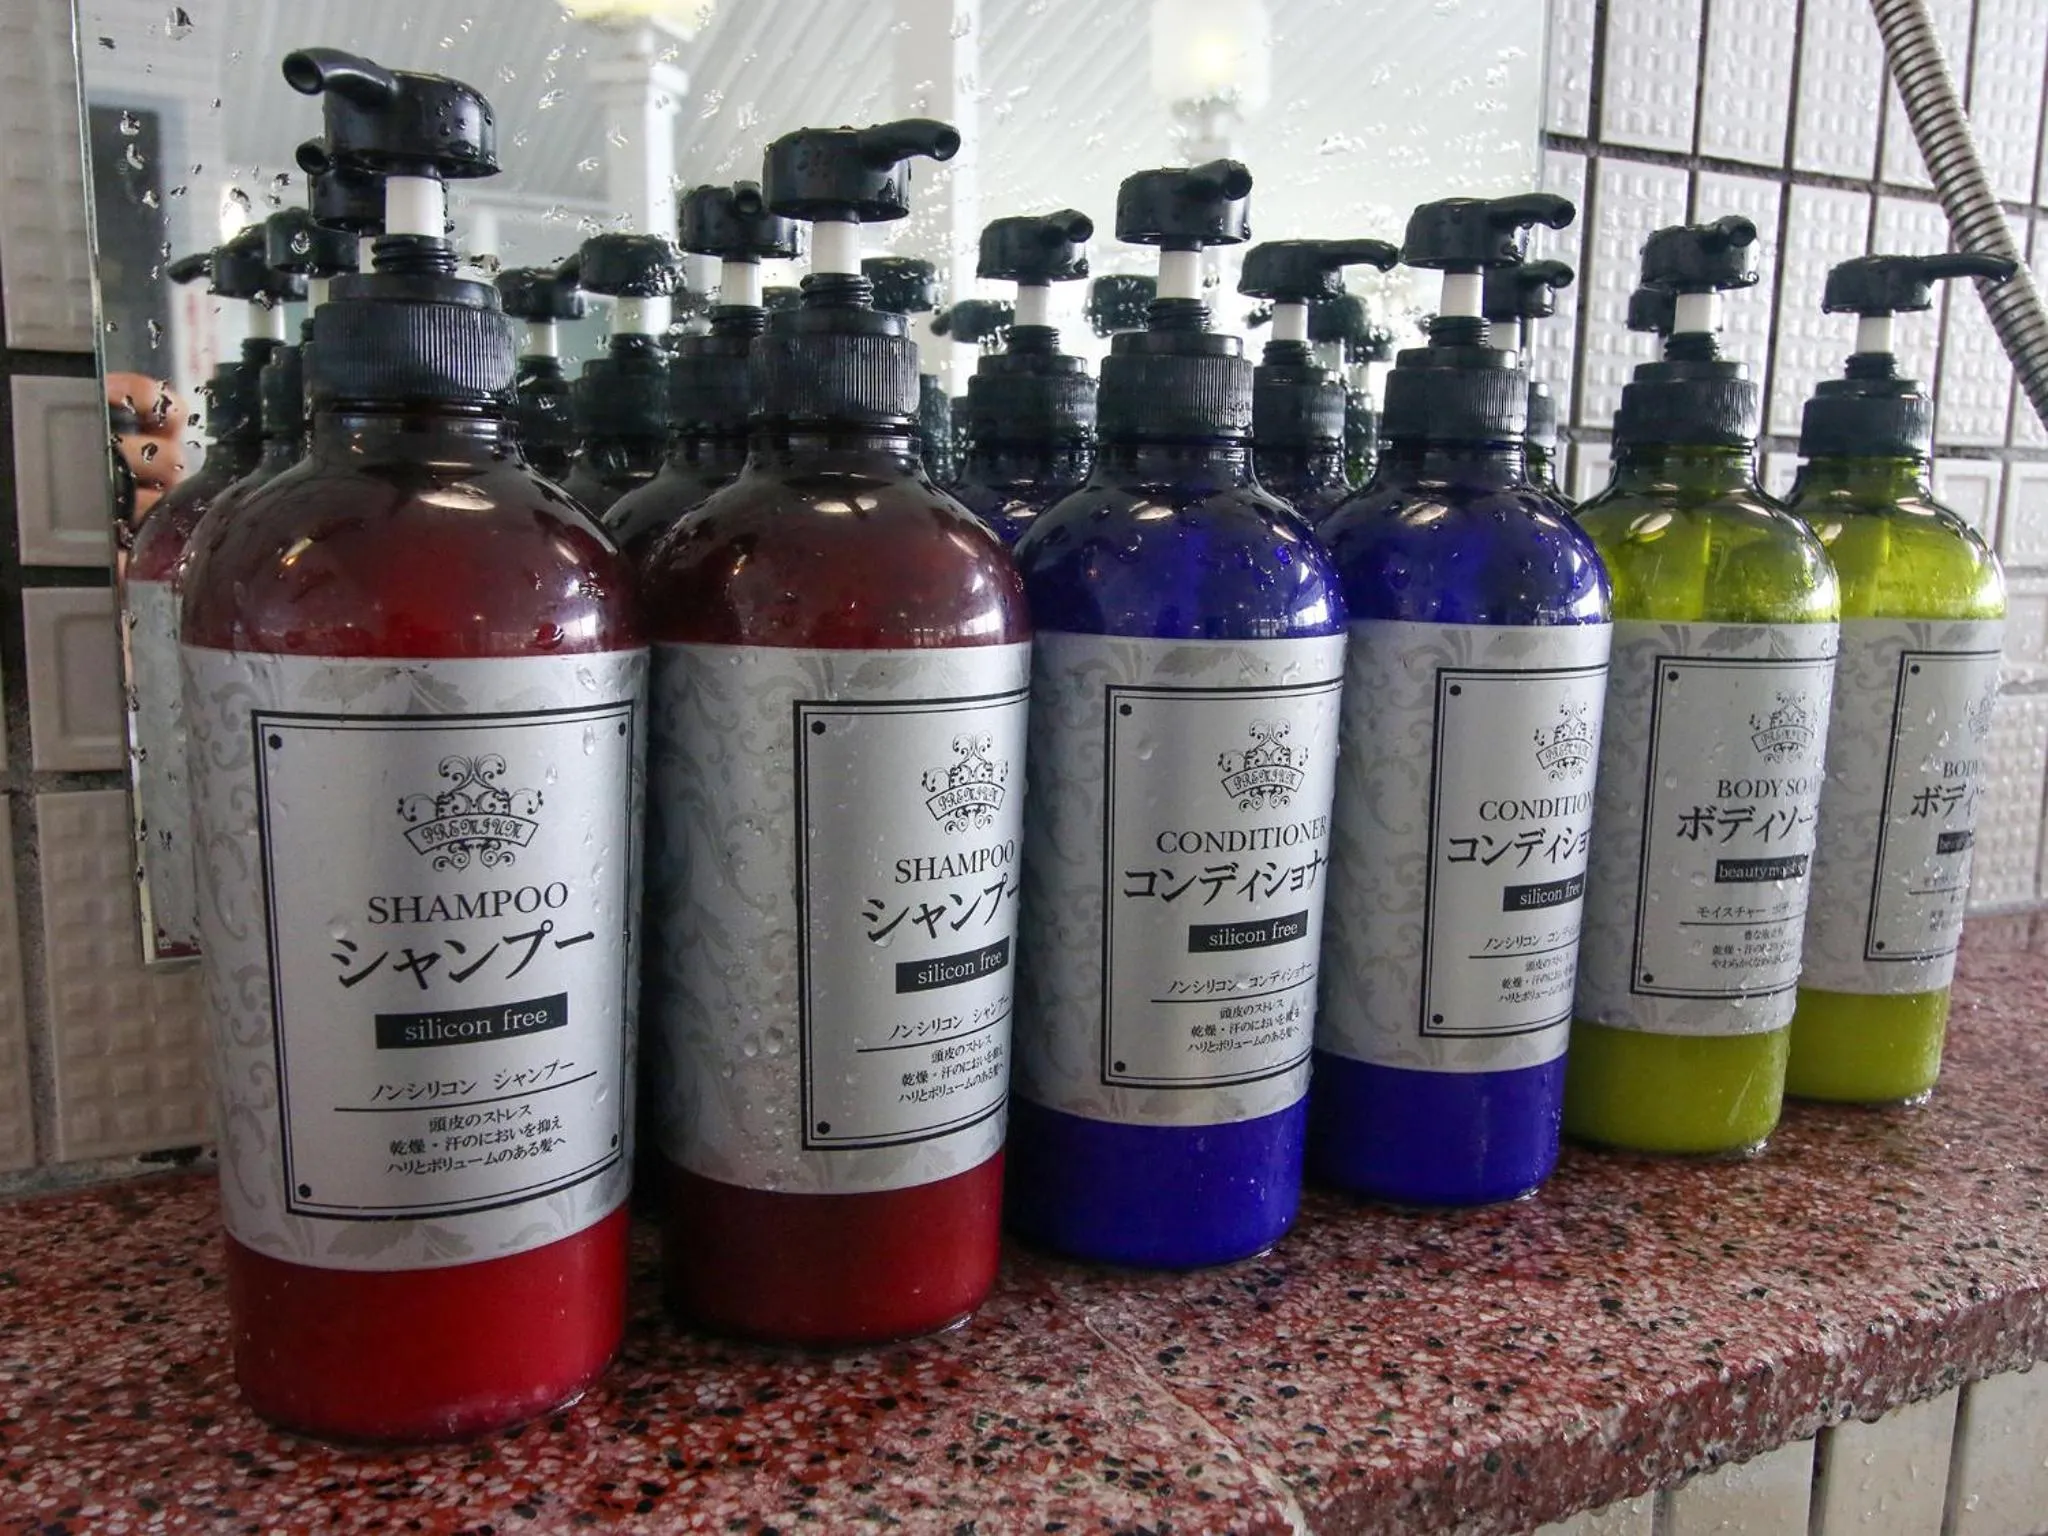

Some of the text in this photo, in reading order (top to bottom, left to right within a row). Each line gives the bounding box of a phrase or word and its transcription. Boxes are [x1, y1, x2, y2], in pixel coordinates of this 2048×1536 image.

[1717, 779, 1782, 799] BODY
[421, 818, 523, 845] PREMIUM
[1156, 815, 1328, 854] CONDITIONER
[895, 839, 1014, 884] SHAMPOO
[1124, 849, 1331, 906] コンディショナー
[368, 882, 569, 924] SHAMPOO
[862, 872, 1019, 943] シャンプー
[1520, 887, 1562, 906] silicon
[1209, 921, 1298, 946] silicon free
[1483, 934, 1540, 952] ノンシリコン
[331, 919, 595, 990] シャンプー
[918, 951, 1002, 985] silicon free
[1168, 979, 1237, 994] ノンシリコン
[405, 1008, 548, 1042] silicon free
[888, 1016, 964, 1041] ノンシリコン
[370, 1058, 575, 1102] ノンシリコン シャンプー
[429, 1104, 533, 1134] 頭皮のストレス
